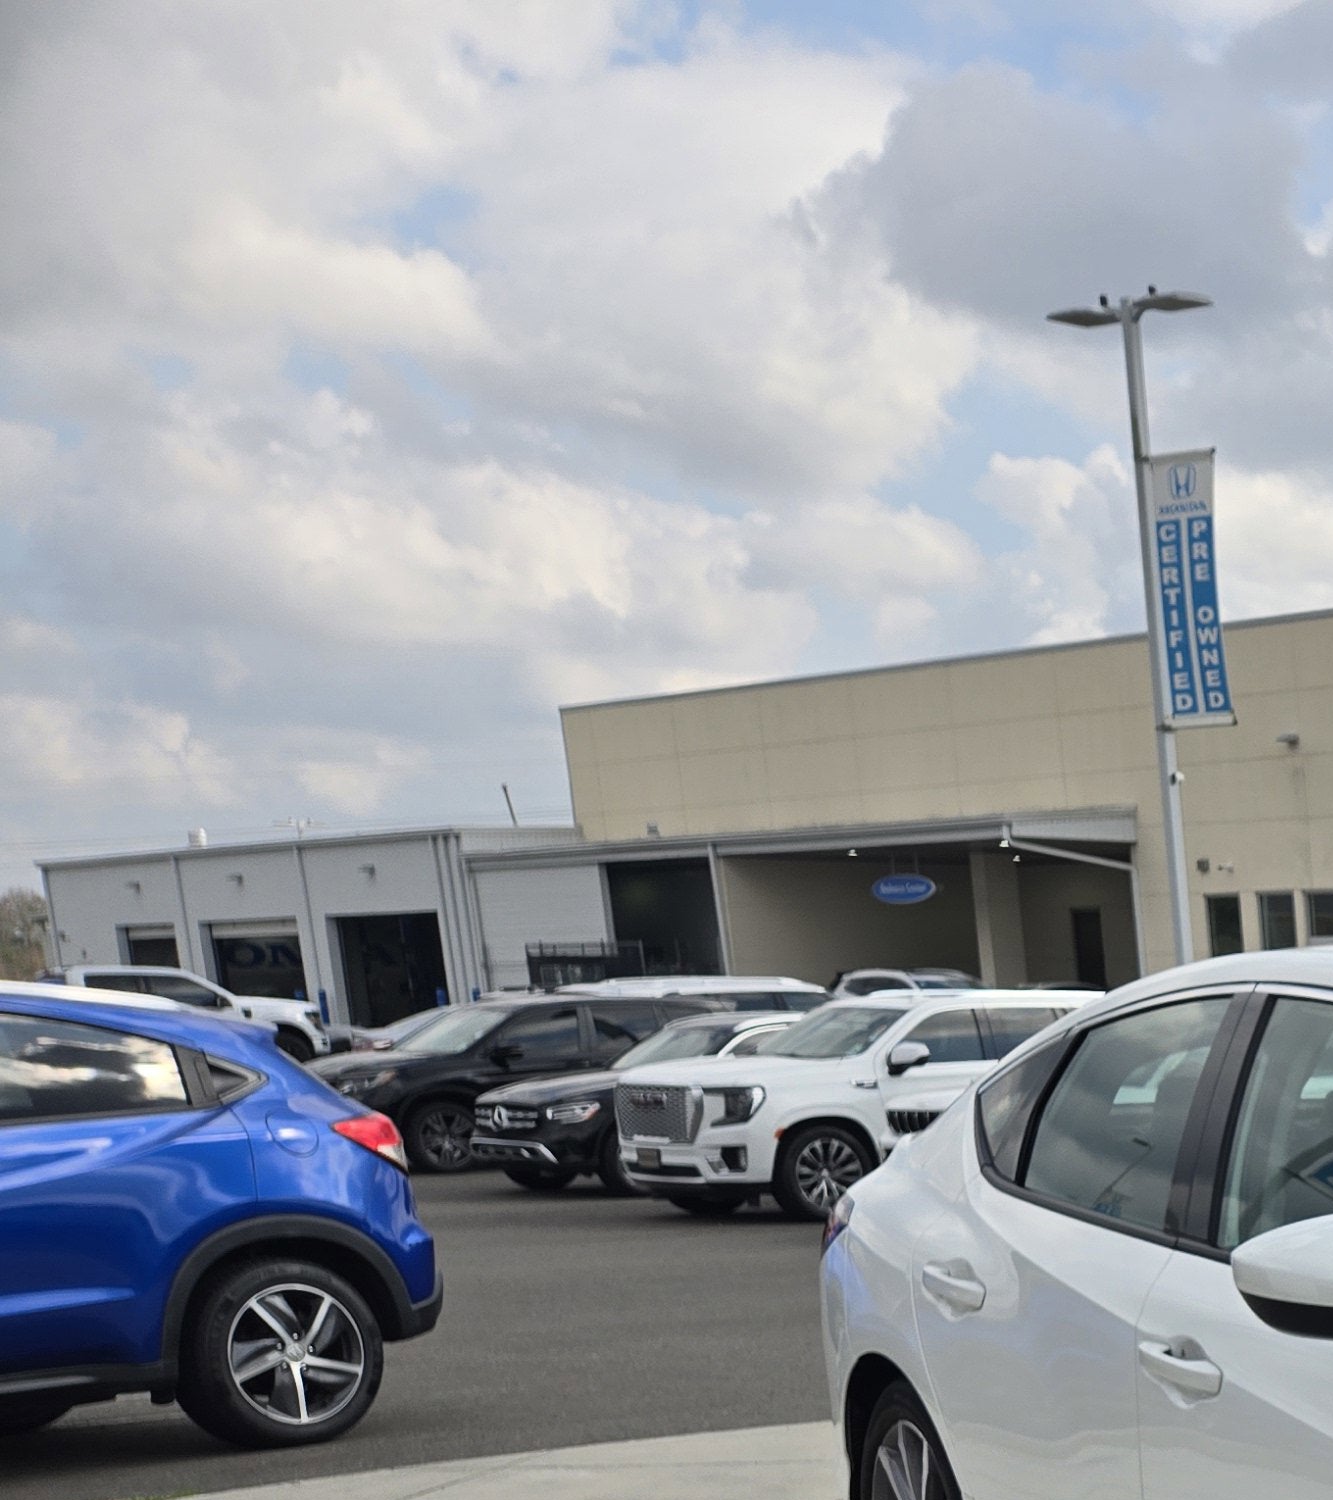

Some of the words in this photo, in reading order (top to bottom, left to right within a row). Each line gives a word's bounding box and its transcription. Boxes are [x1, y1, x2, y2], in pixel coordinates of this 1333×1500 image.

[1190, 519, 1211, 581] PRE
[1158, 523, 1195, 712] CERTIFIED
[1197, 604, 1225, 709] OWNED
